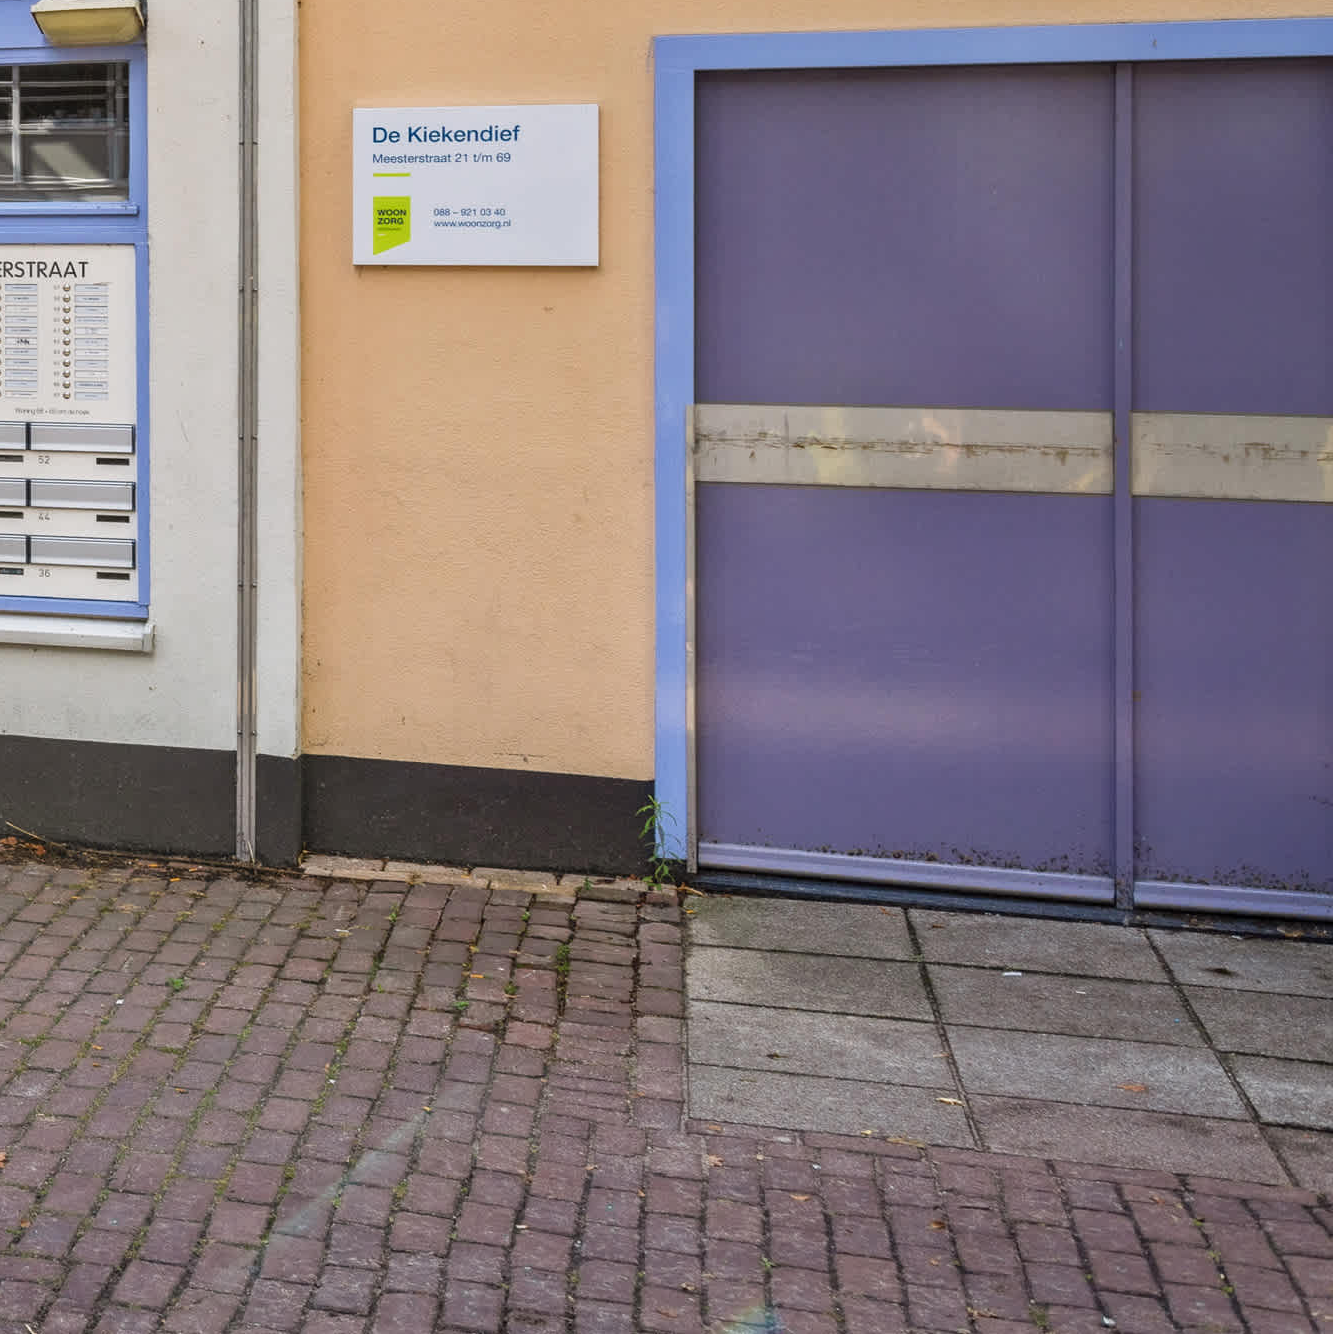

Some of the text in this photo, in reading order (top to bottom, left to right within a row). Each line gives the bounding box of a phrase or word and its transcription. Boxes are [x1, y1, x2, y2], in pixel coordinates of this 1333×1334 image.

[372, 124, 521, 144] De Kiekendief
[372, 152, 511, 165] Meesterstraat 21 t/m 69
[376, 208, 407, 217] WOON
[433, 208, 451, 217] 088
[460, 208, 477, 217] 921
[479, 208, 492, 217] 03
[493, 208, 506, 217] 40
[377, 217, 404, 226] ZORG
[433, 219, 512, 230] www.woonzorg.nl
